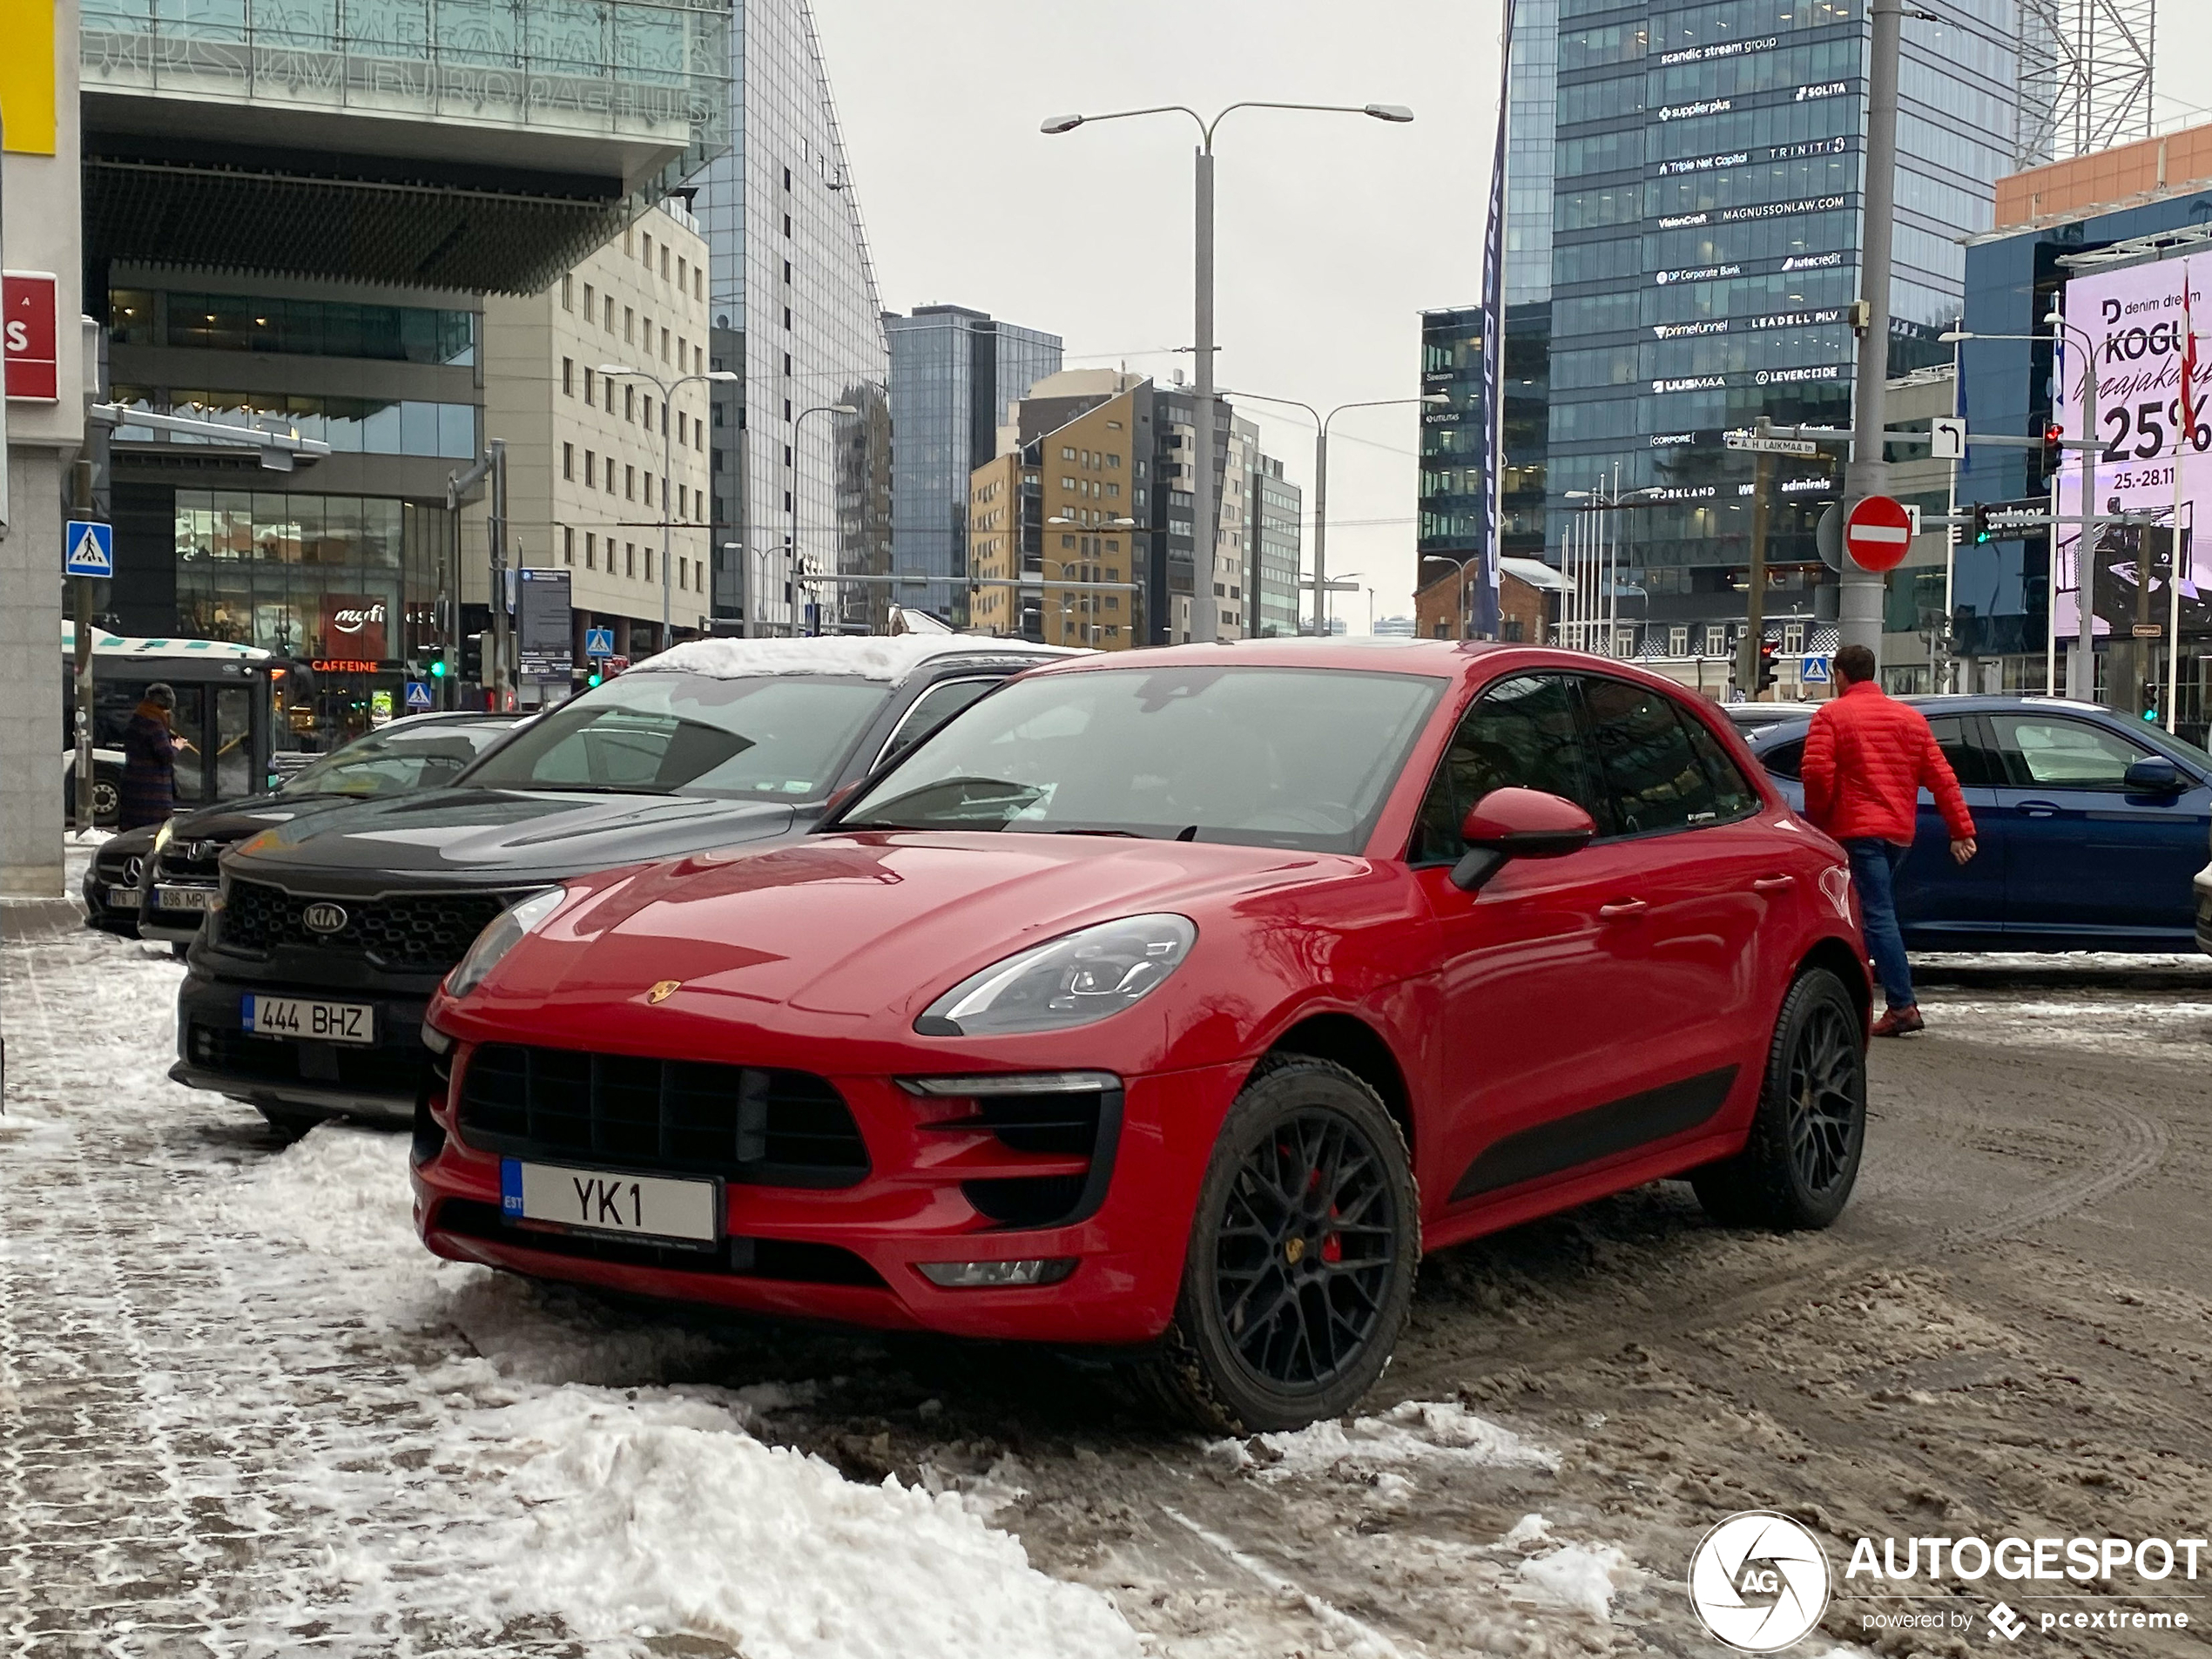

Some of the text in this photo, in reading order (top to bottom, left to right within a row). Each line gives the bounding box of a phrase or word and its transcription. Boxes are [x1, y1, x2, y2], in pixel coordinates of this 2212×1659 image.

[1661, 37, 1777, 64] scandic stream group
[1808, 82, 1846, 98] SOLITA
[1669, 152, 1748, 173] Triple Net Capital
[1723, 196, 1845, 220] MAGNUSSONLAW.COM
[1668, 264, 1742, 281] OP Corporate Bank
[2125, 298, 2160, 315] denim
[2163, 290, 2202, 308] drem
[1751, 310, 1838, 328] LEADELL PILV
[1664, 319, 1729, 339] primefunnel
[1665, 375, 1726, 392] UUSMAA
[1764, 441, 1803, 452] LAIKMAA
[1781, 476, 1831, 492] admirals
[312, 660, 378, 673] CAFFEINE
[162, 892, 181, 907] 696
[308, 907, 338, 927] KIA
[262, 1001, 362, 1037] 444 BHZ
[504, 1195, 523, 1209] EST
